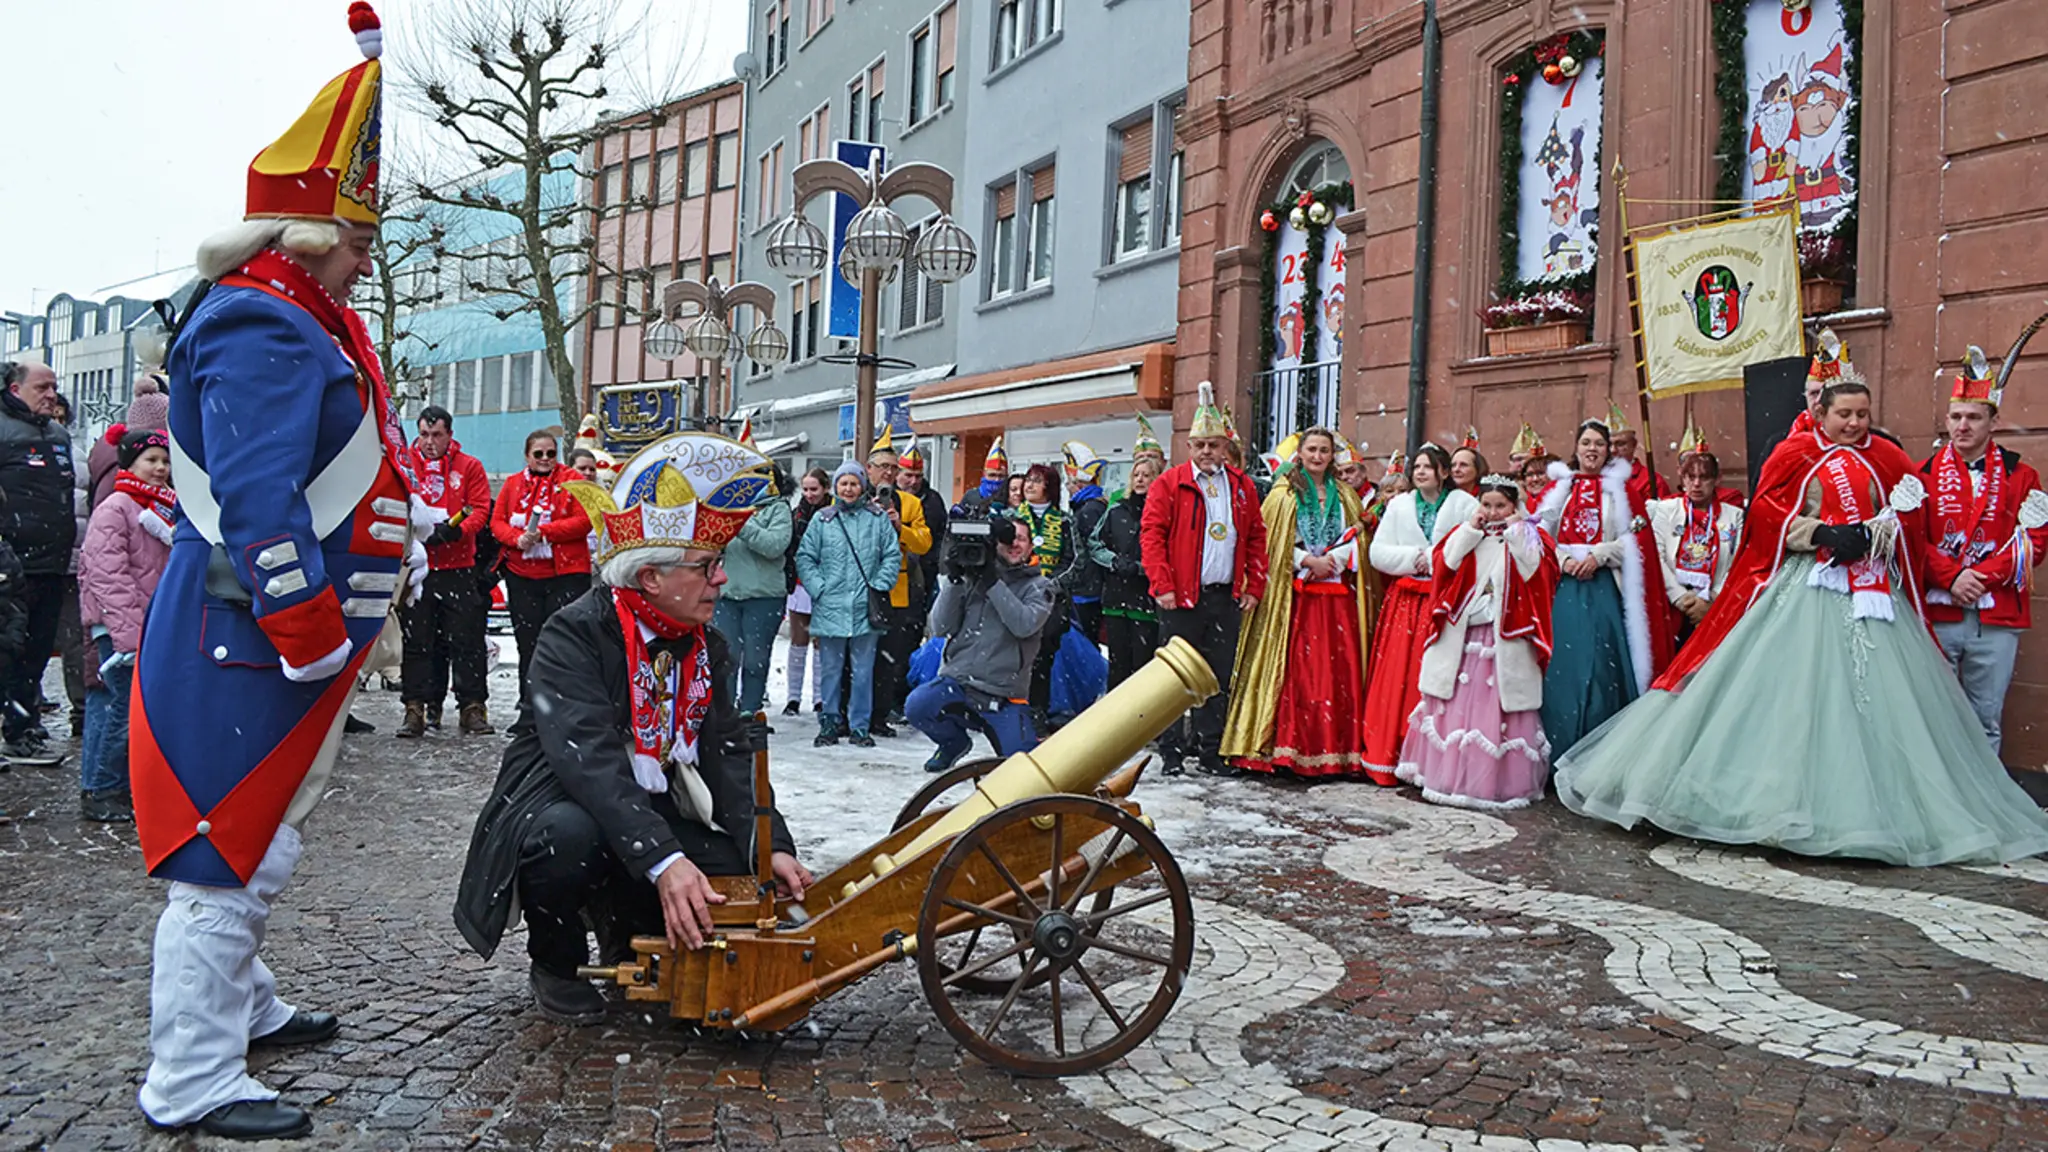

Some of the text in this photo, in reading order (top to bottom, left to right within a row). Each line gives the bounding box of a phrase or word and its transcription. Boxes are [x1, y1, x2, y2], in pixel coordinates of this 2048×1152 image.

[1667, 244, 1763, 279] Karnevalverein
[1674, 329, 1768, 358] Kaiserslautern
[1938, 463, 1962, 493] 1955
